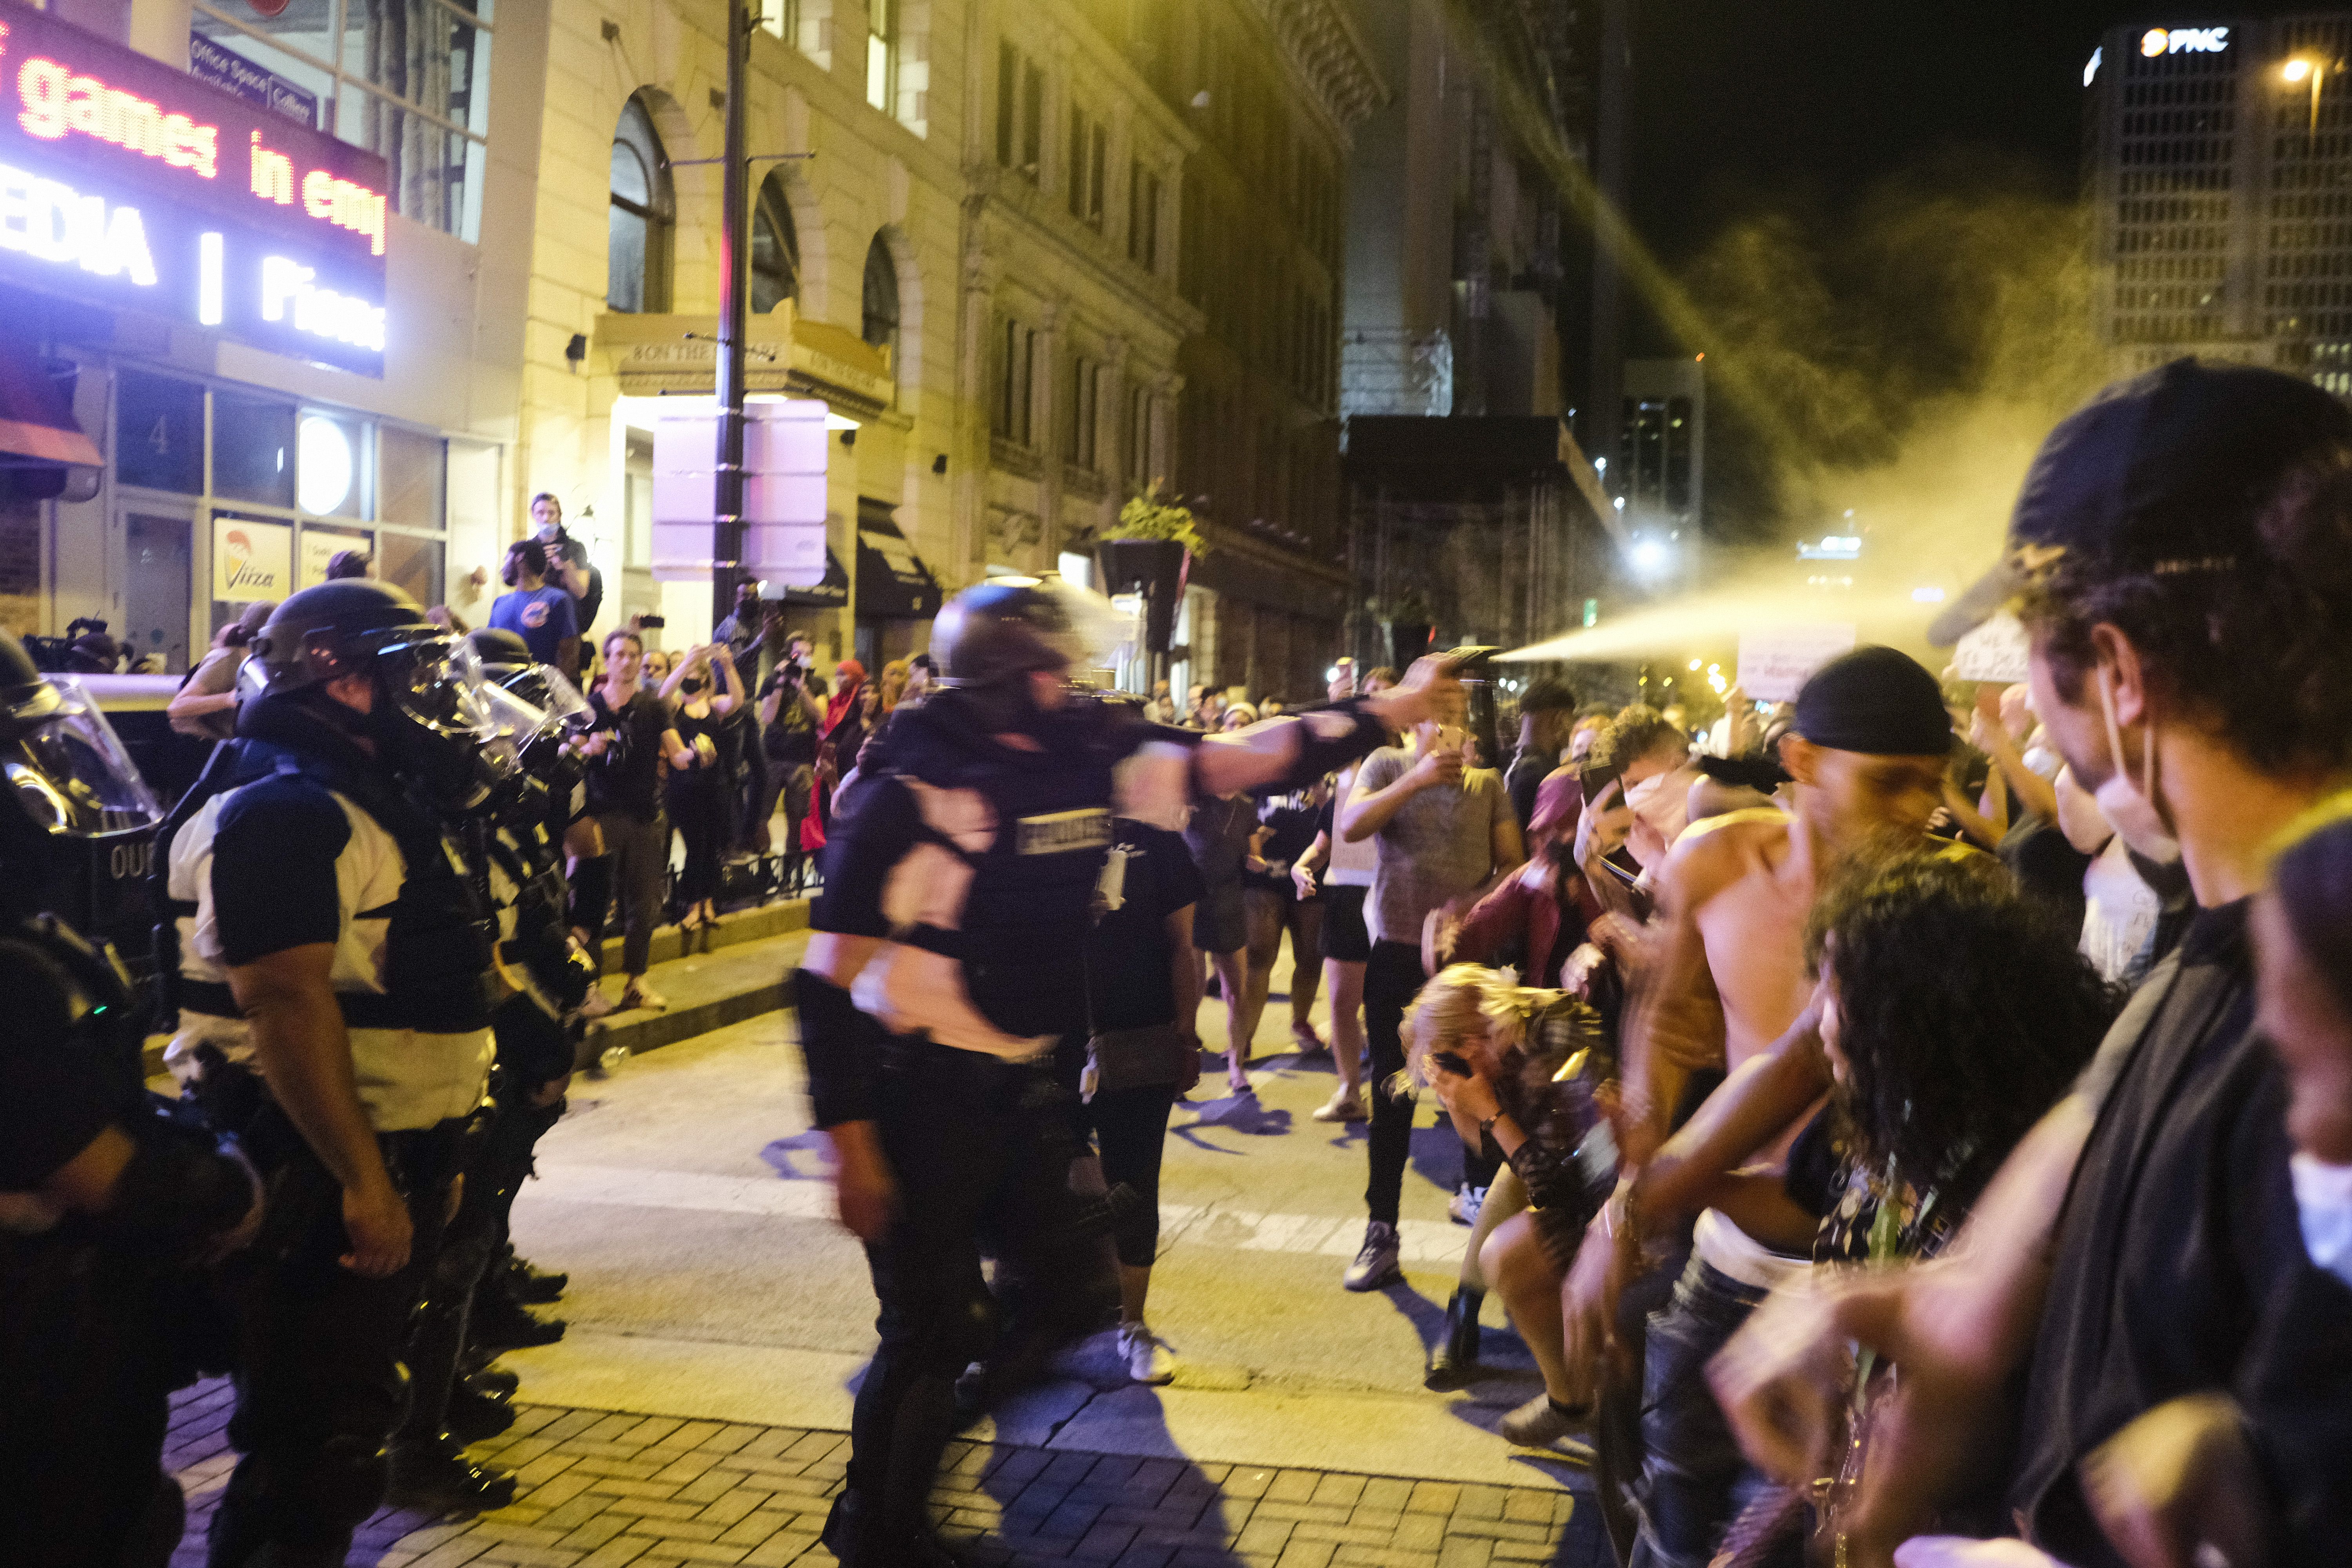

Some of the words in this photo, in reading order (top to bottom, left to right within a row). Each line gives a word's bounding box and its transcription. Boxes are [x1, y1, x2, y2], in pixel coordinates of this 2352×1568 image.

[2169, 27, 2229, 54] PNC
[18, 58, 218, 178] games
[251, 130, 294, 204] in
